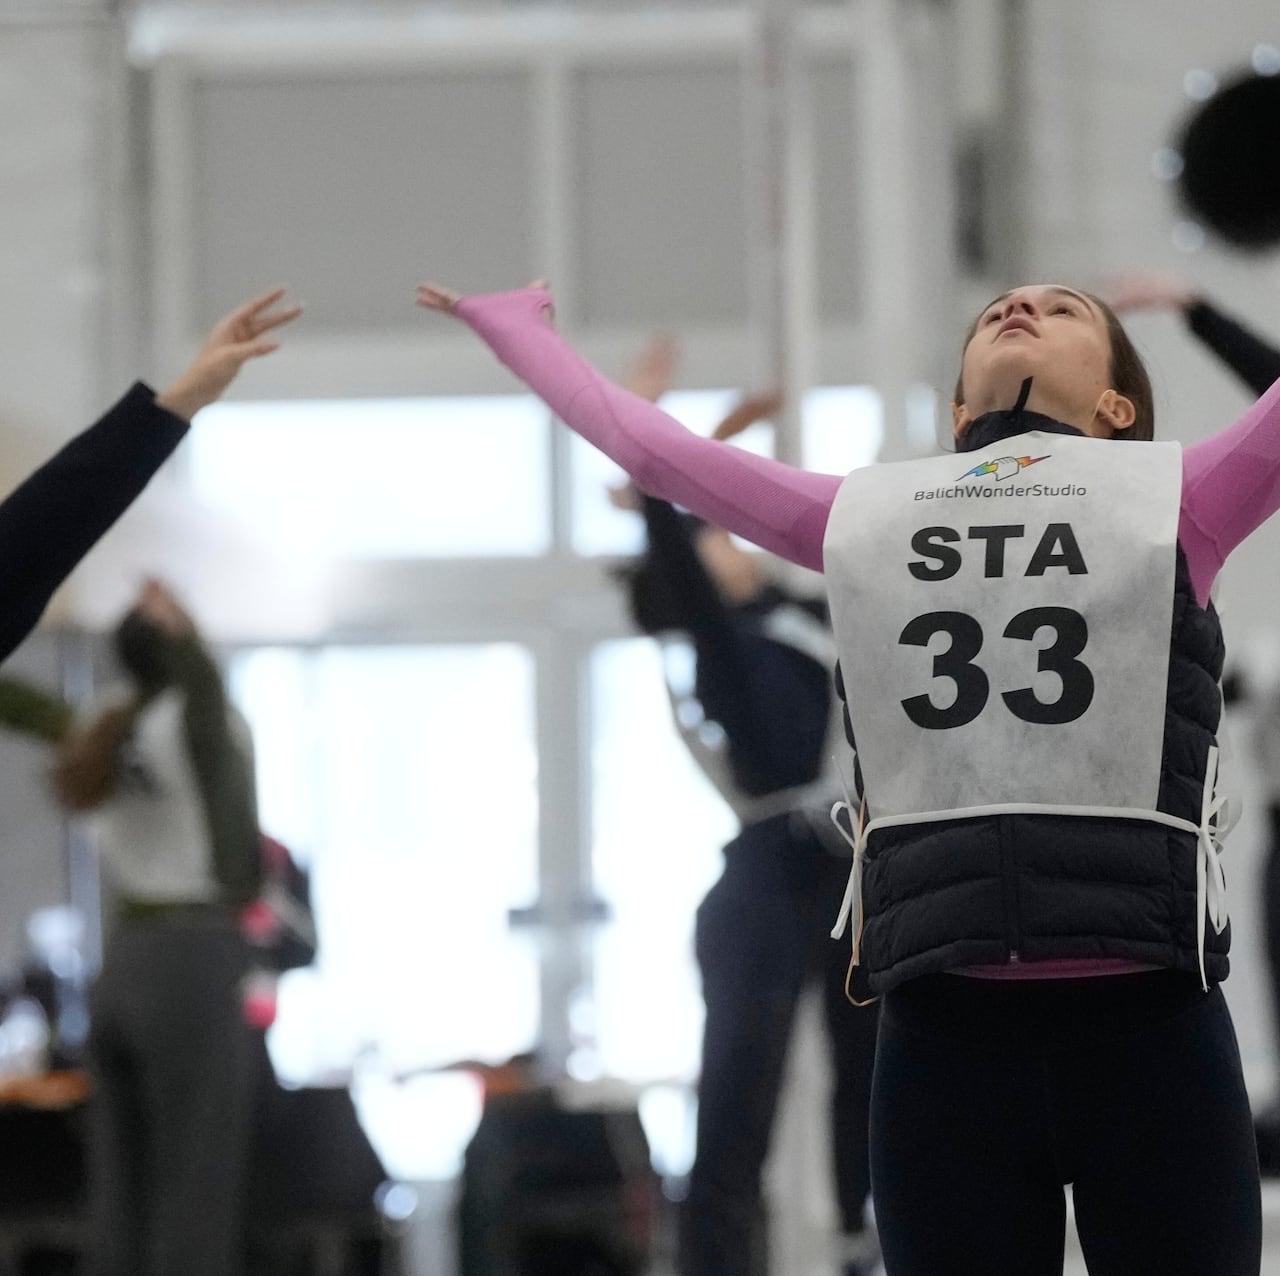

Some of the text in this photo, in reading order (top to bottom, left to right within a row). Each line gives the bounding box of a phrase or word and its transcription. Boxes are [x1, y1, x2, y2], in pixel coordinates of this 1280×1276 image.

[913, 484, 1088, 501] BalichWonderStudio
[907, 523, 1089, 581] STA
[898, 606, 1095, 730] 33
